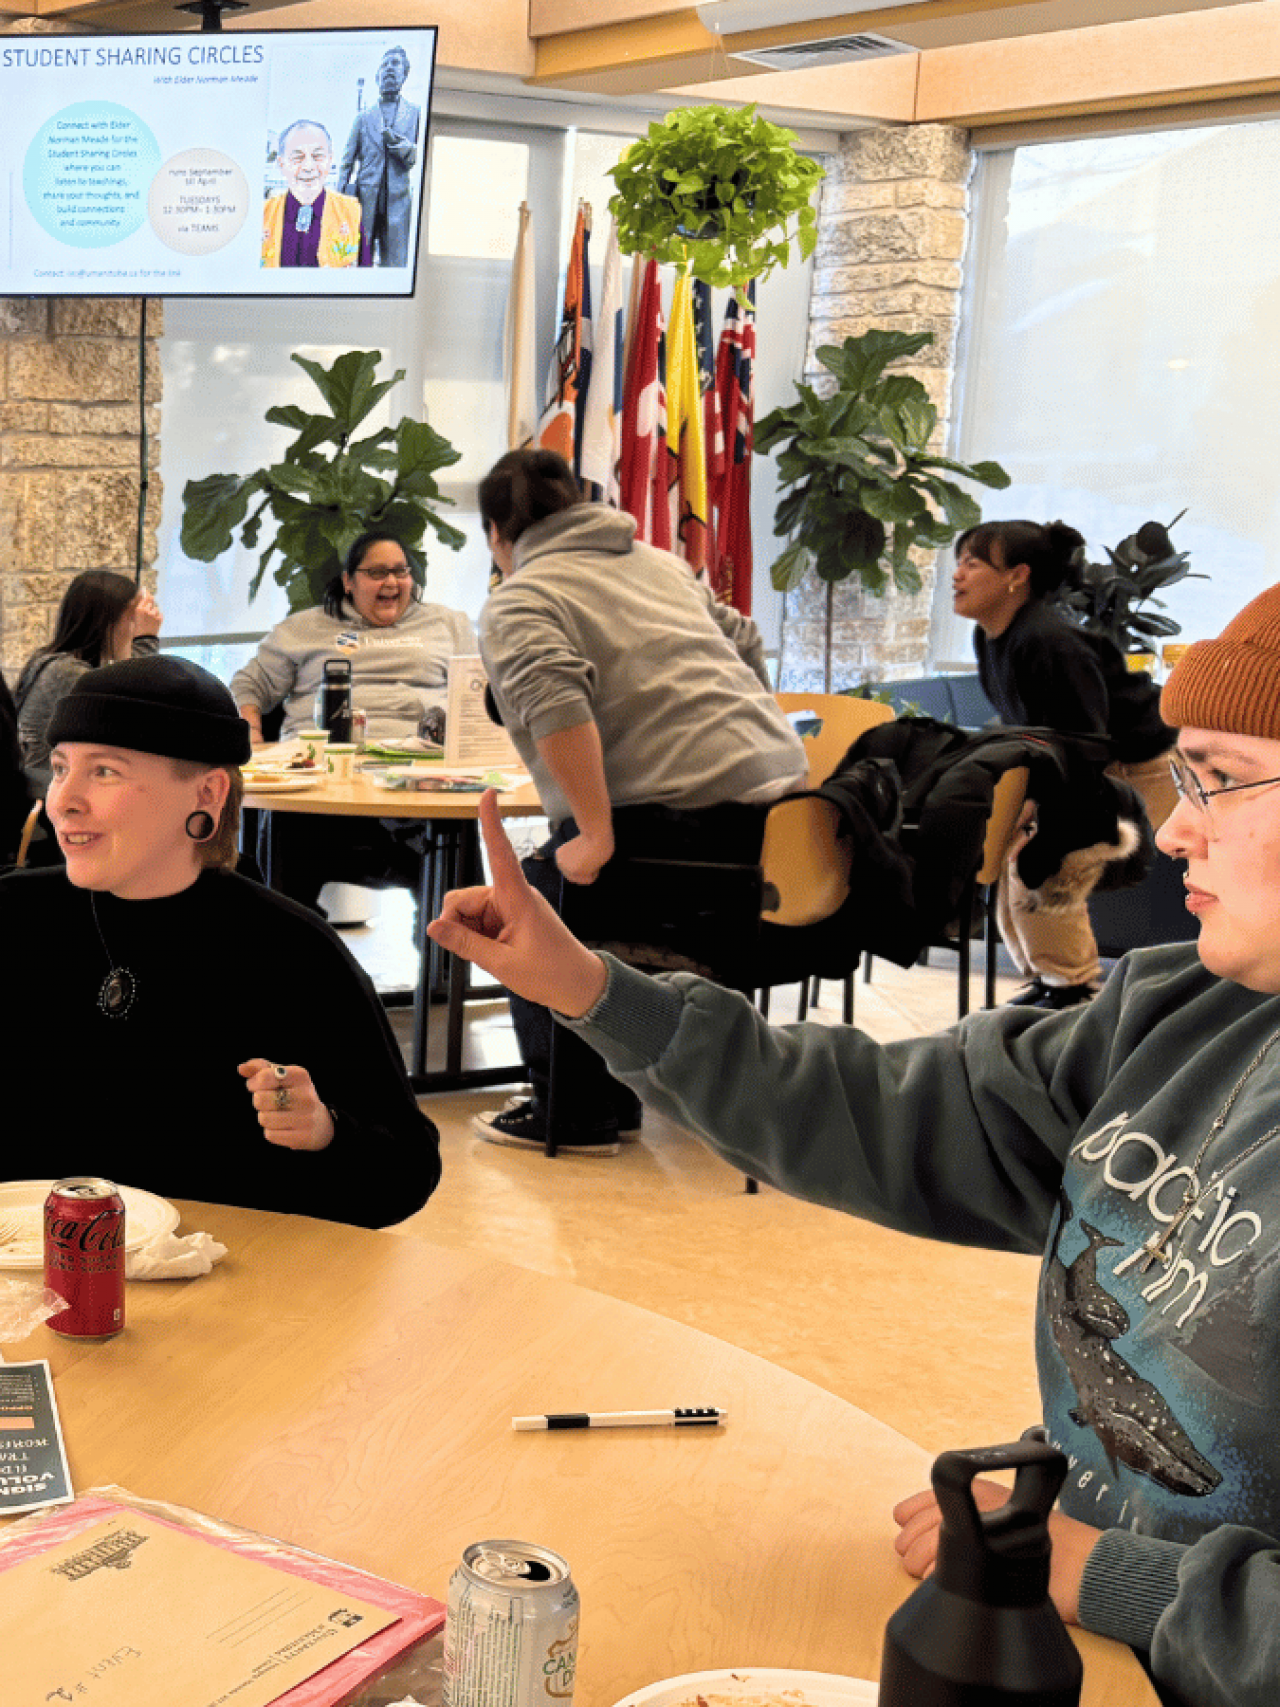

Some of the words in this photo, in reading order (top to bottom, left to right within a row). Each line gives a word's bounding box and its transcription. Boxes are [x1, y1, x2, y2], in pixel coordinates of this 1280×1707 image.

[2, 48, 91, 67] STUDENT
[95, 46, 181, 66] SHARING
[187, 45, 264, 65] CIRCLES
[174, 75, 194, 84] Elder
[195, 75, 228, 84] Norman
[231, 74, 258, 83] Meade
[56, 120, 90, 130] Connect
[90, 121, 108, 130] with
[110, 120, 131, 130] Elder
[111, 134, 123, 144] for
[124, 134, 138, 144] the
[48, 150, 78, 158] Student
[80, 150, 110, 160] Sharing
[111, 150, 138, 158] Circles
[64, 163, 89, 172] where
[90, 164, 105, 173] you
[124, 190, 140, 199] and
[56, 204, 77, 214] build
